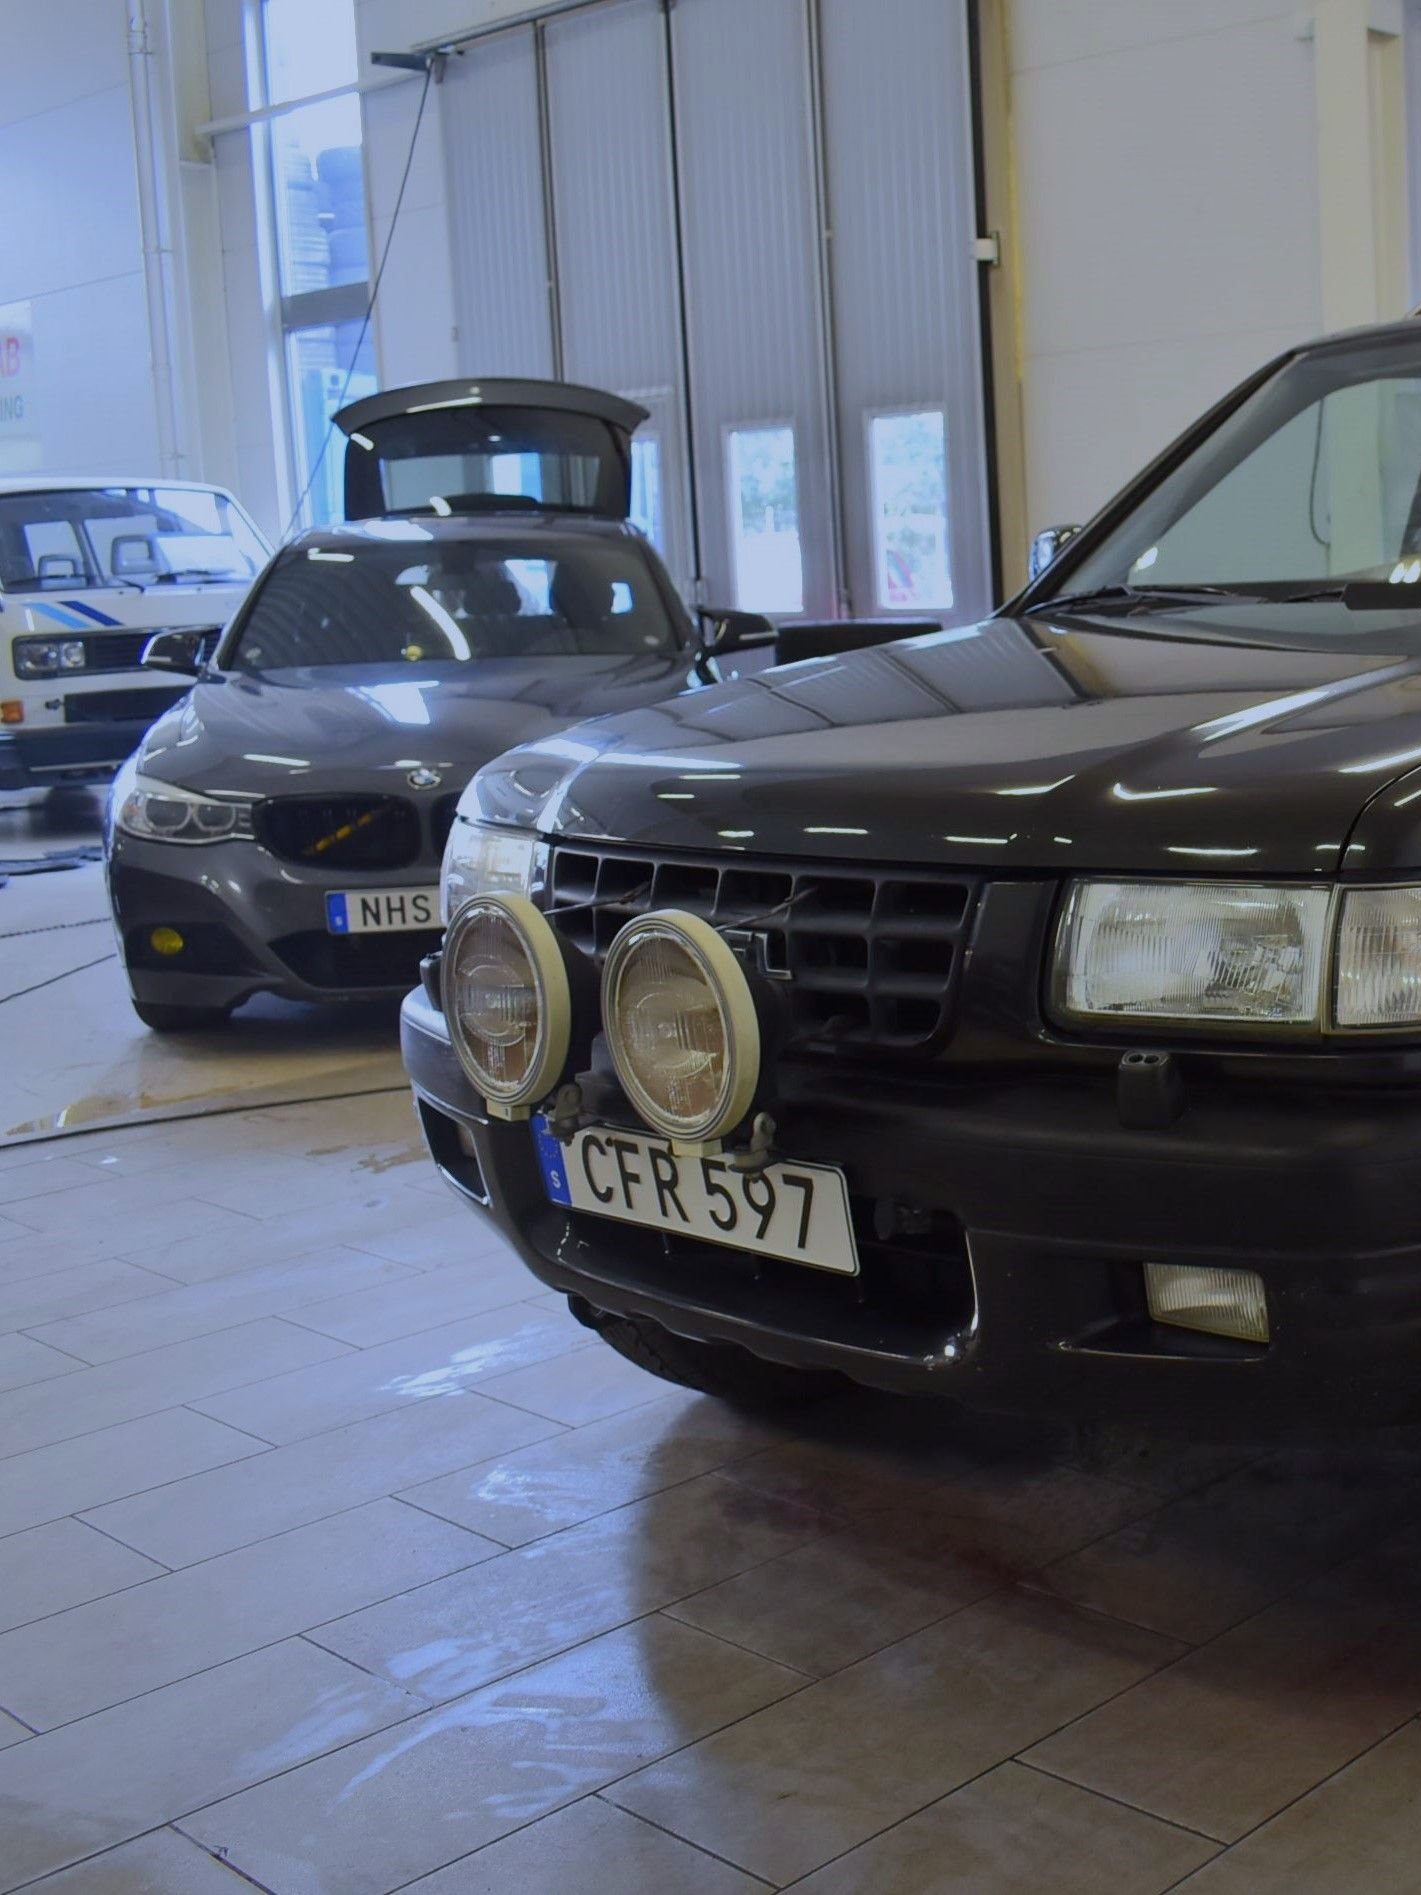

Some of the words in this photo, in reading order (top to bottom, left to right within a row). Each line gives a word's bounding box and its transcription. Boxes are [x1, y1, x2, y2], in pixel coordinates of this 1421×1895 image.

[361, 894, 431, 926] NHS
[551, 1170, 562, 1189] S
[581, 1134, 690, 1223] CFR
[700, 1157, 813, 1249] 597
